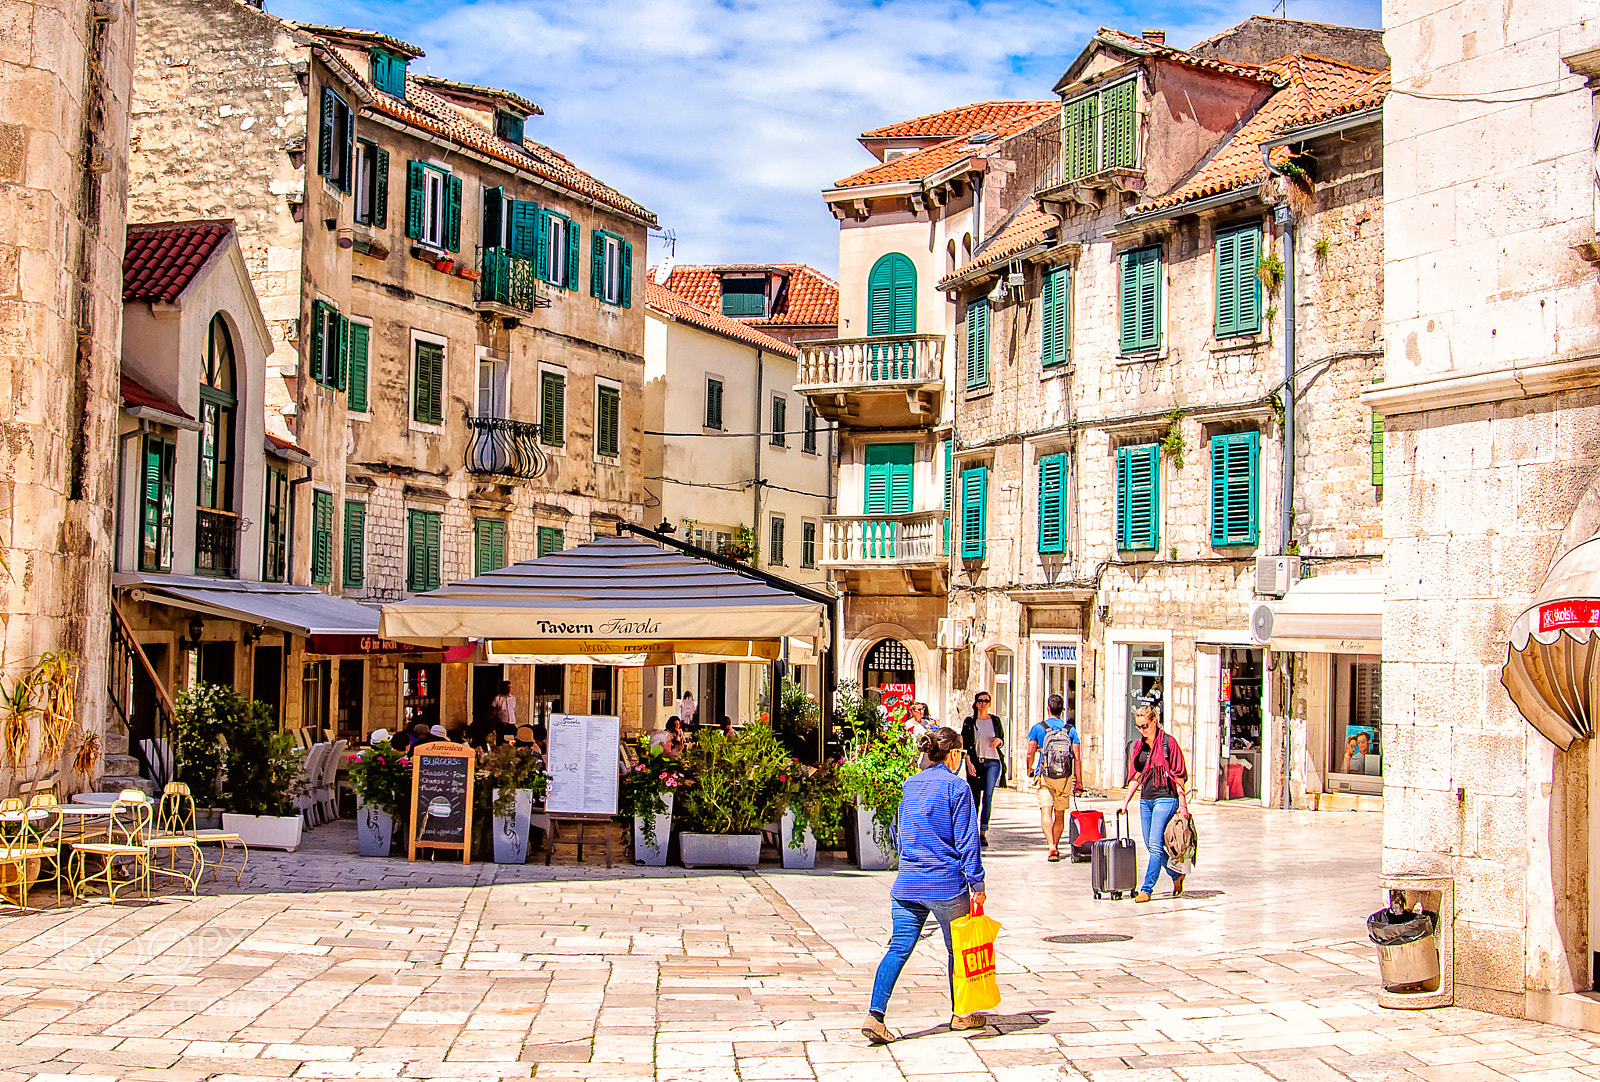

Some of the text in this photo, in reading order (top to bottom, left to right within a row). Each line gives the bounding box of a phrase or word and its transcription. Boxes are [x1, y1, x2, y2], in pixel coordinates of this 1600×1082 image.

[536, 618, 662, 634] Tavern Favola
[1042, 645, 1077, 661] BIRKENSTOCK
[884, 683, 912, 693] AKCIJA
[422, 757, 461, 766] BURGERS:
